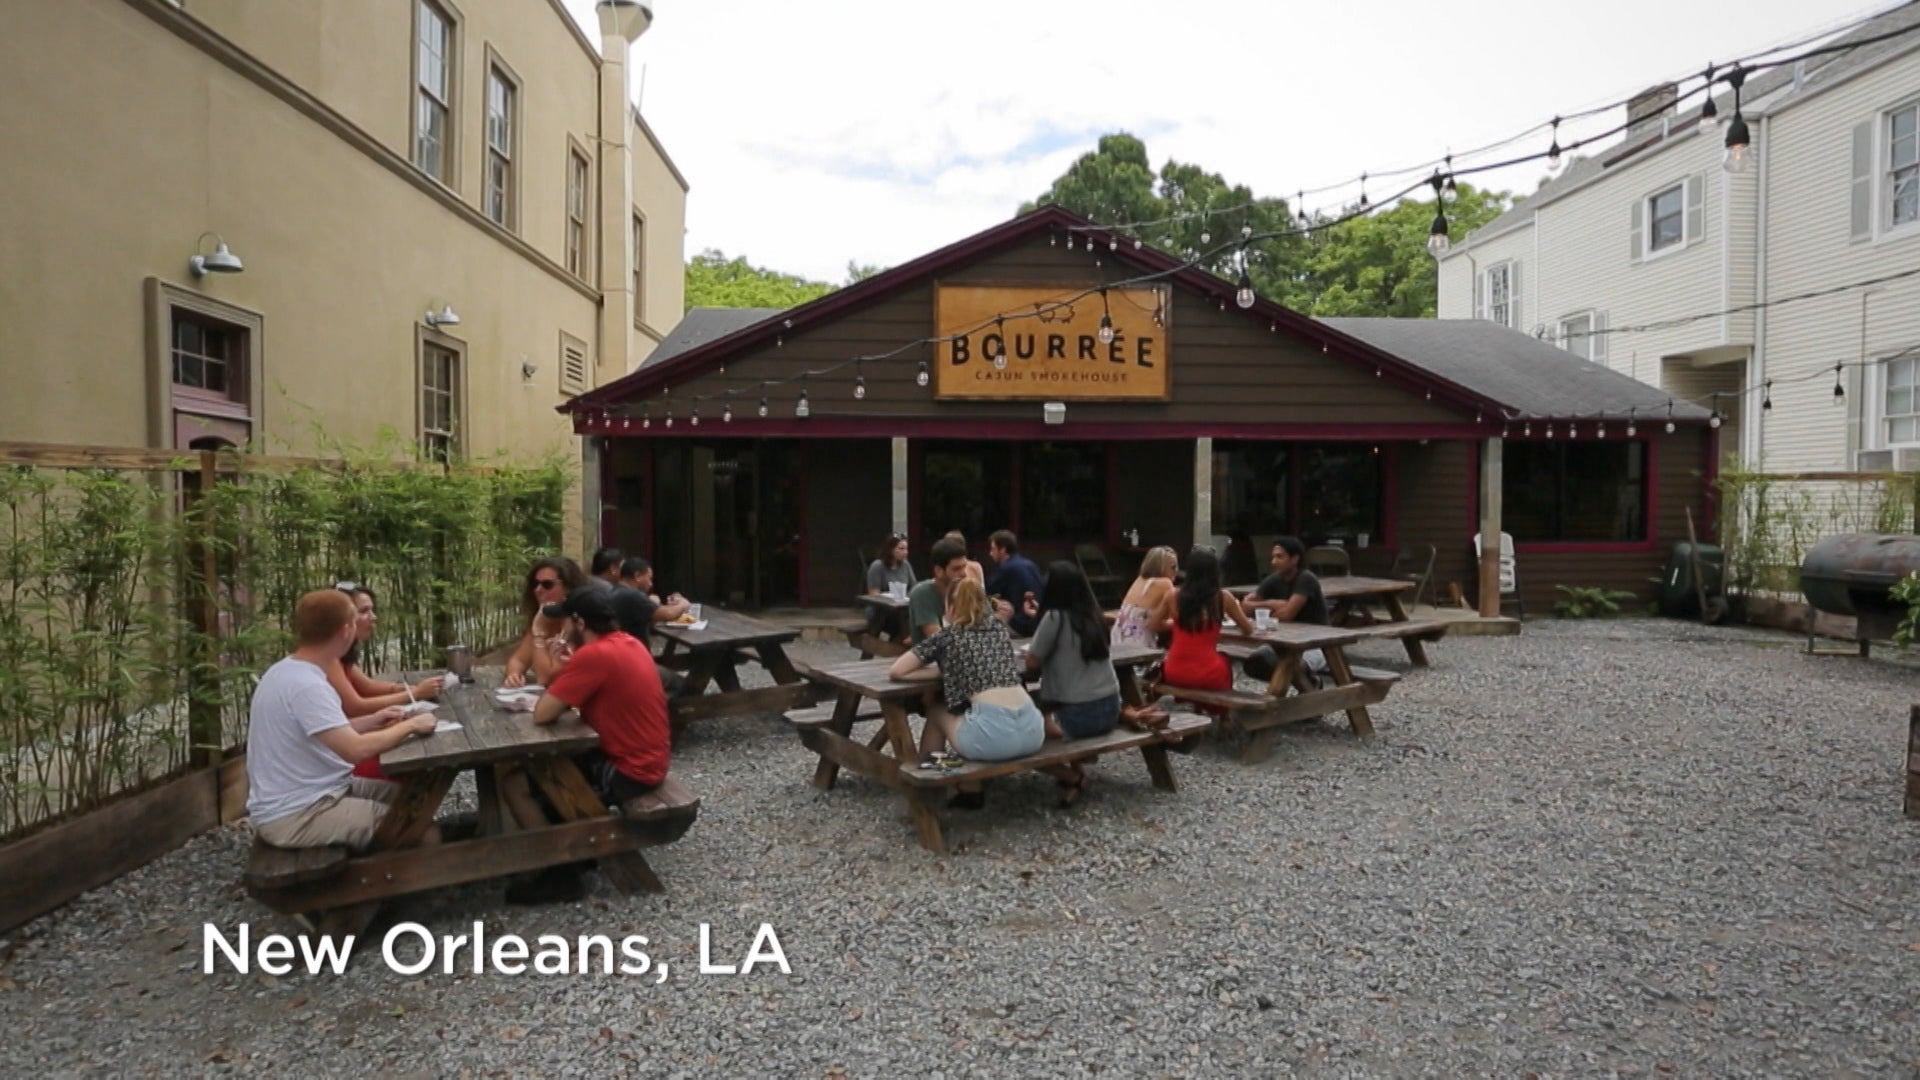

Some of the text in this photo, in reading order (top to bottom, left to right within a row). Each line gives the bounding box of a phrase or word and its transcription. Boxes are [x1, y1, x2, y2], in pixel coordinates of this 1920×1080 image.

[951, 329, 1154, 368] BOURRÉE
[975, 371, 1129, 383] CAJUN SMOKEHOUSE
